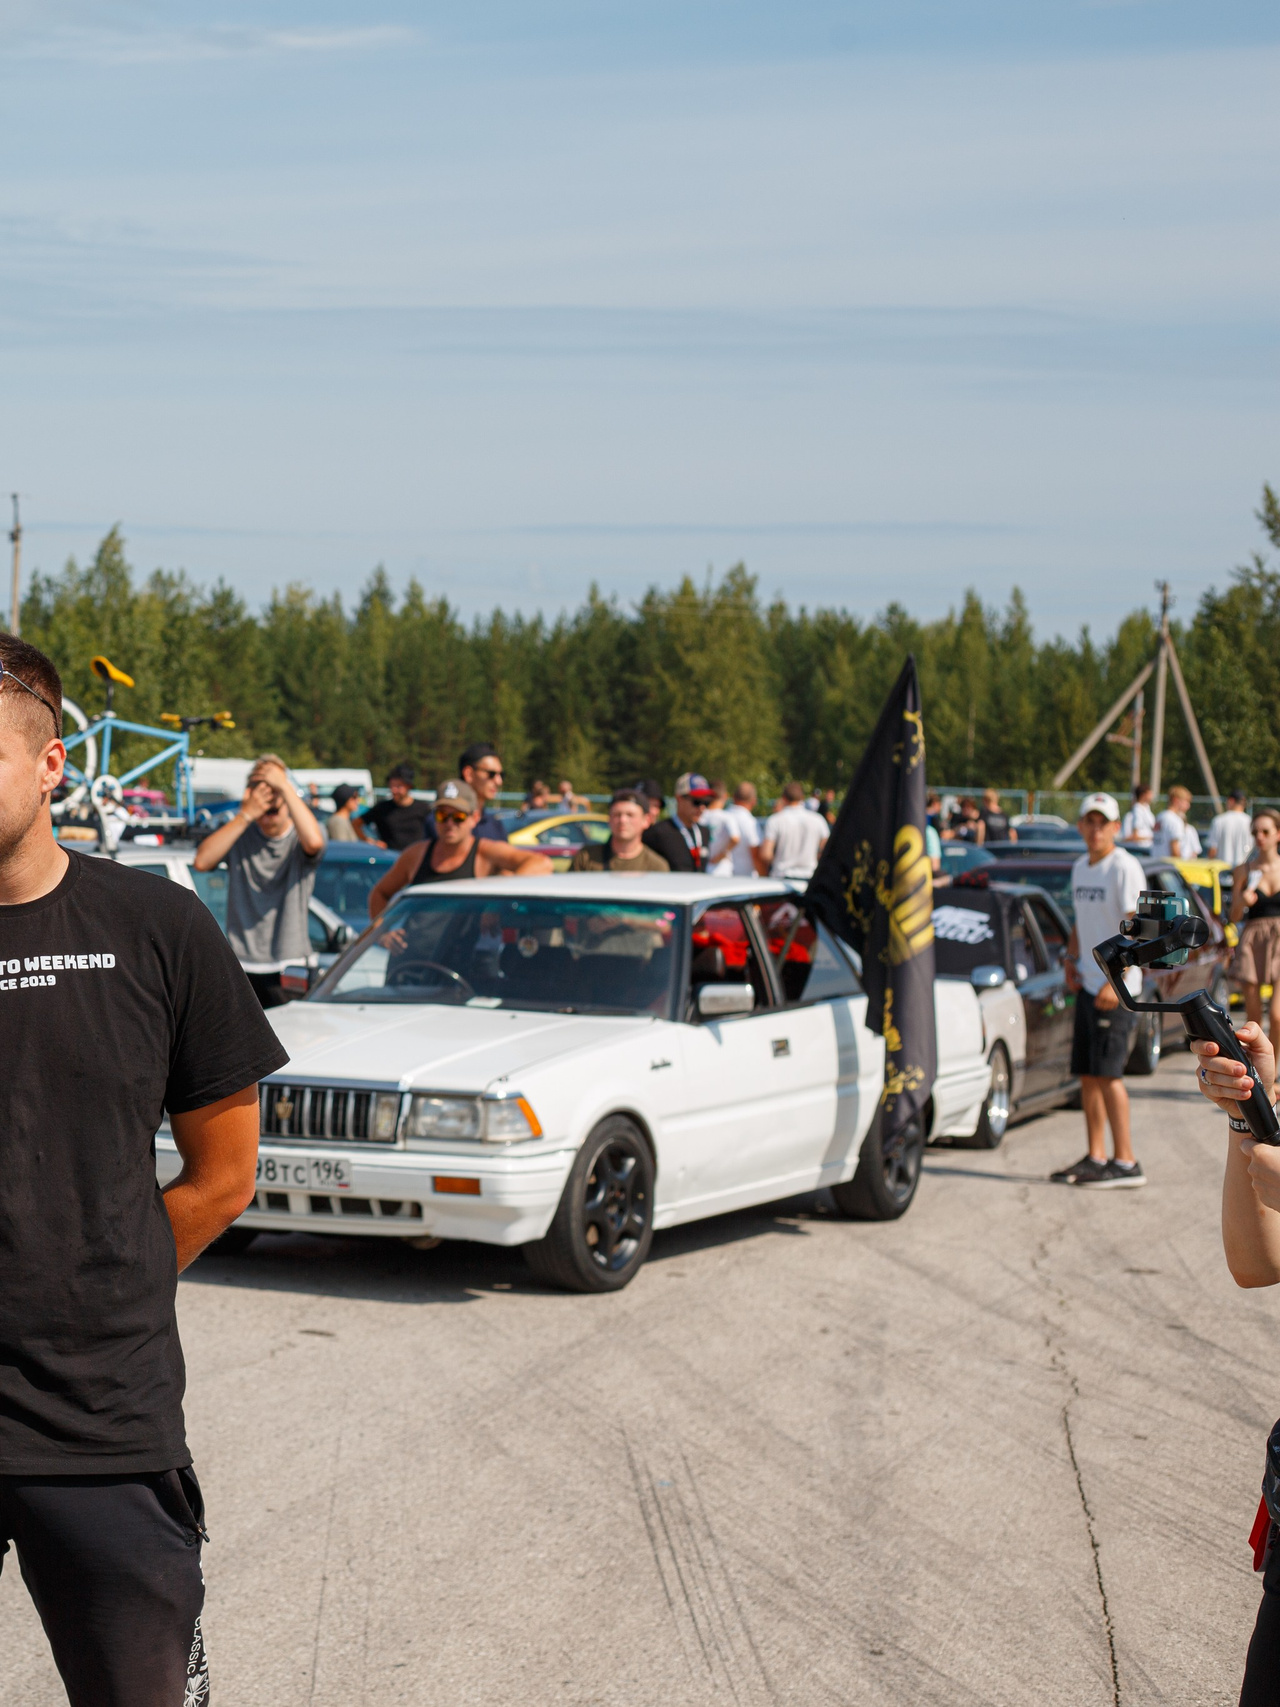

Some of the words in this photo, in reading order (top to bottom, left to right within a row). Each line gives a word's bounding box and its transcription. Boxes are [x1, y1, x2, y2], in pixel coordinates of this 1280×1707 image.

[24, 953, 116, 972] WEEKEND
[20, 974, 57, 989] 2019
[312, 1161, 345, 1181] 196
[186, 1615, 202, 1675] CLASSIC
